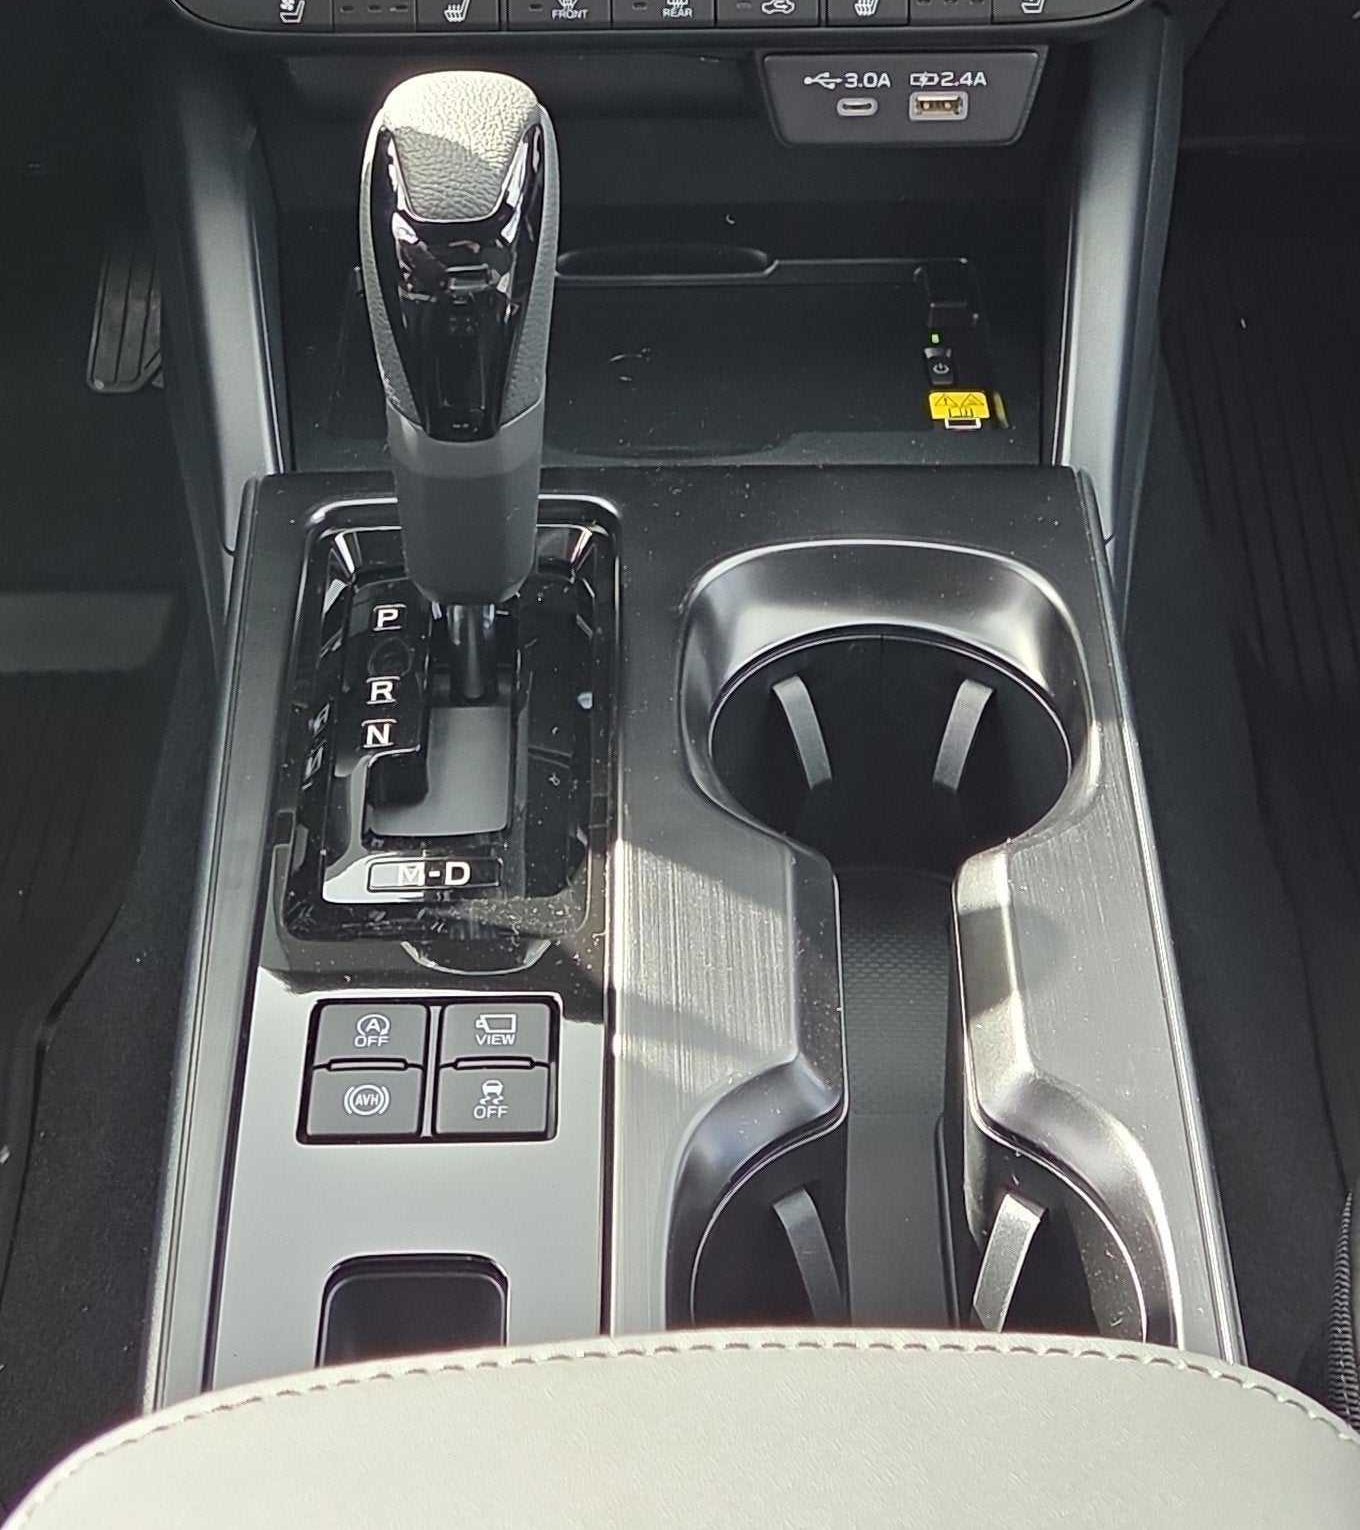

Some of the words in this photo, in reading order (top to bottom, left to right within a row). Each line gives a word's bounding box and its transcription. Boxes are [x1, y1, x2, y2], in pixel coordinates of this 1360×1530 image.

[551, 9, 589, 20] FRONT
[662, 7, 693, 18] REAR
[844, 72, 891, 89] 3.0A
[940, 71, 987, 88] 2.4A
[376, 608, 401, 628] P
[370, 681, 395, 702] R
[366, 723, 390, 745] N
[353, 1035, 389, 1048] OFF
[475, 1033, 517, 1046] VIEW
[354, 1093, 378, 1107] AVH
[473, 1106, 509, 1120] OFF
